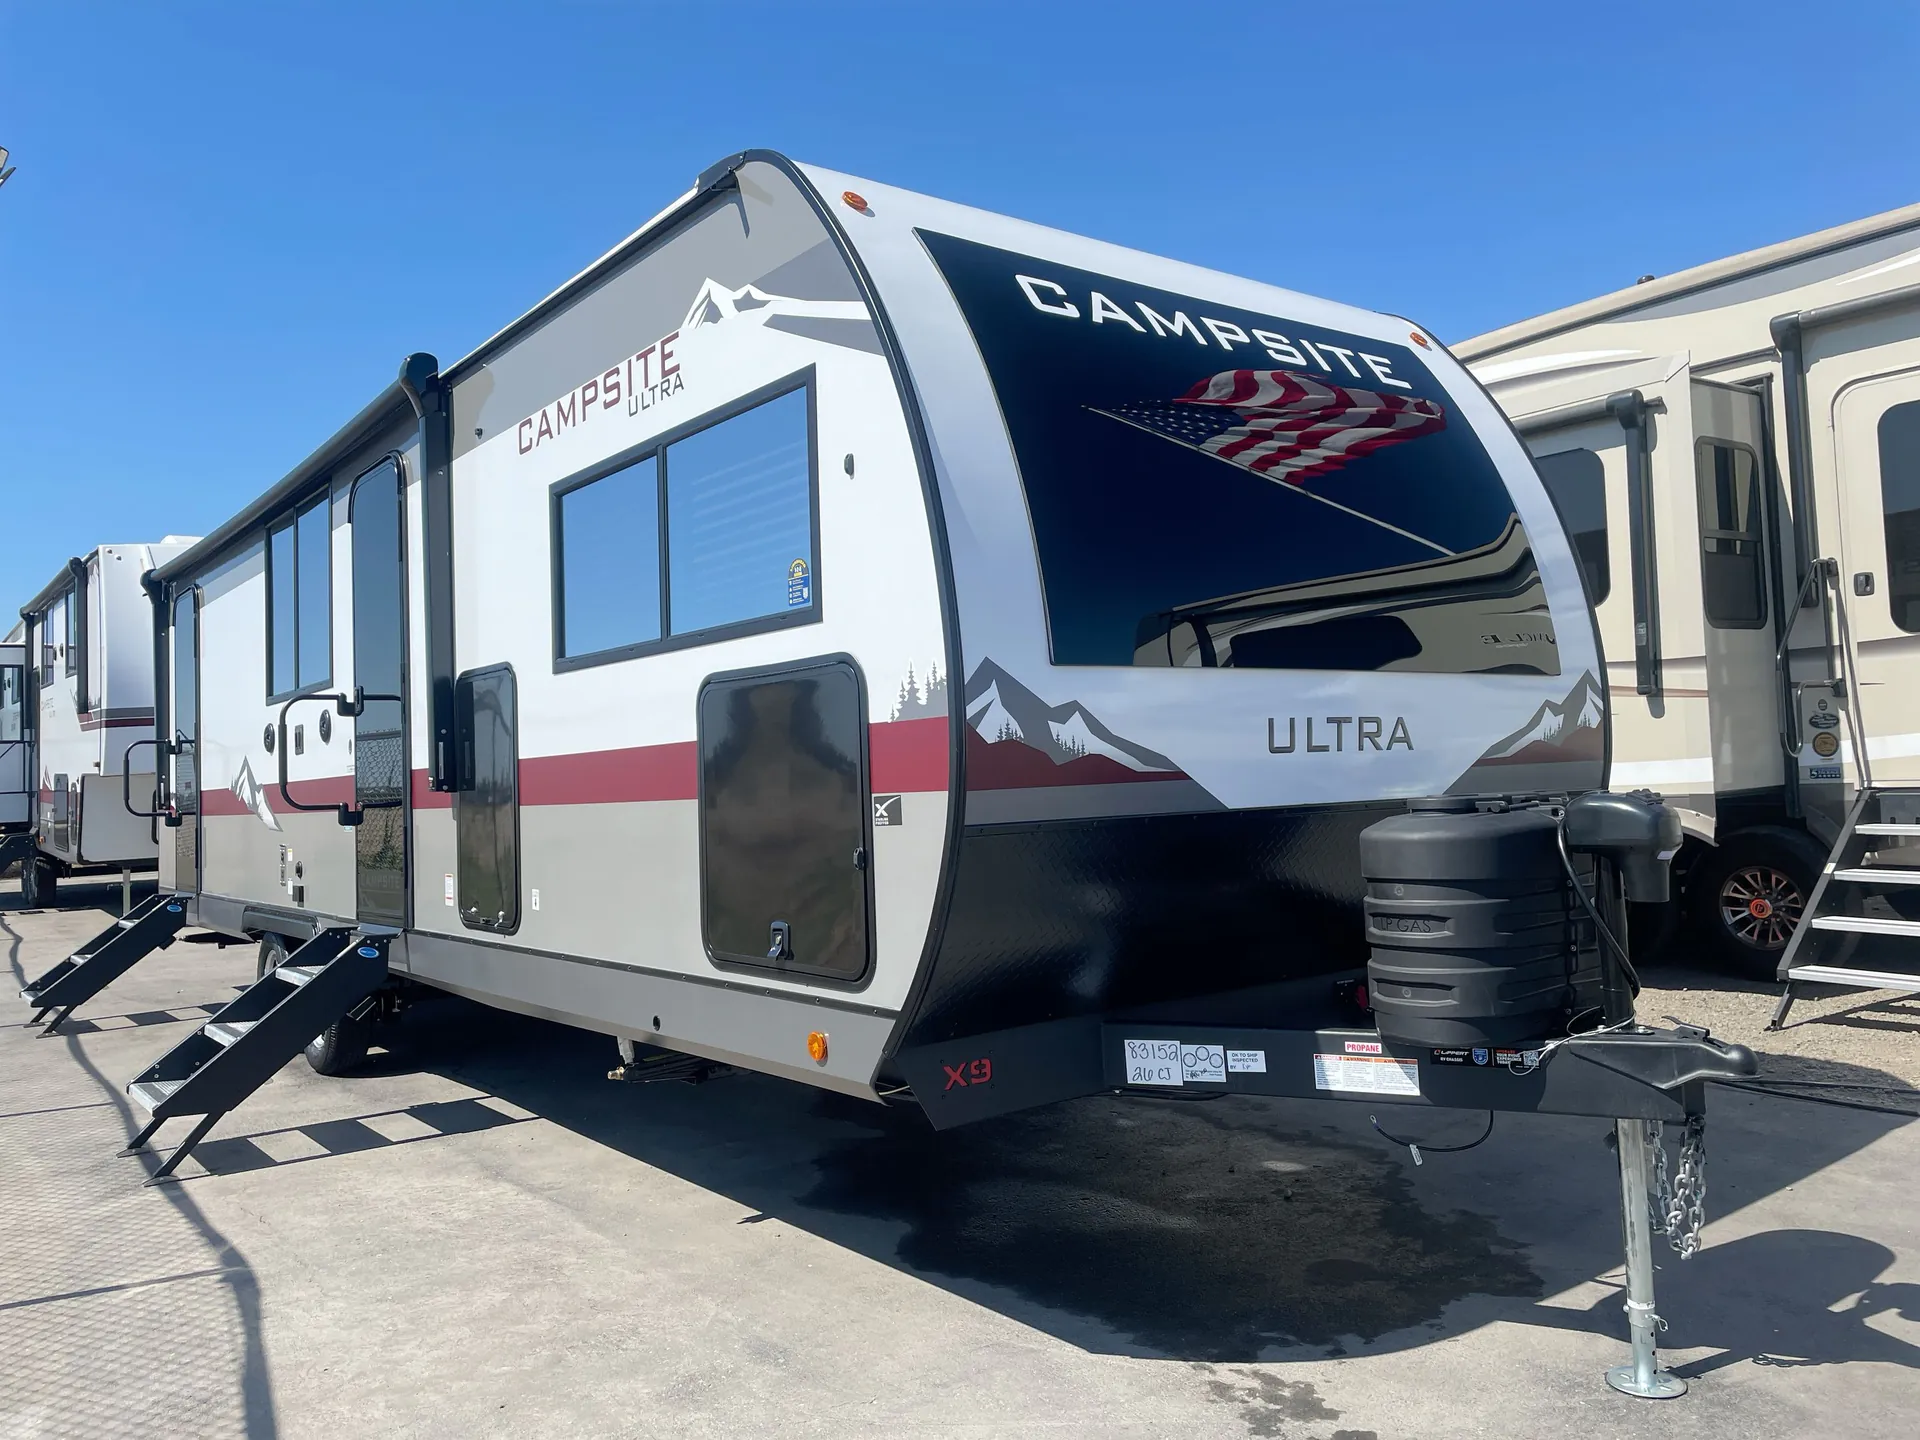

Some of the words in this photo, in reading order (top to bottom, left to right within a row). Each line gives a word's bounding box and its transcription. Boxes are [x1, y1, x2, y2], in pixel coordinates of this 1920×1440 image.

[1014, 273, 1413, 390] CAMPSITE
[518, 330, 681, 456] CAMPSITE
[627, 372, 685, 418] ULTRA
[1268, 716, 1415, 754] ULTRA
[1397, 918, 1432, 933] GAS
[1127, 1041, 1179, 1061] 83152
[1346, 1043, 1380, 1052] PROPANE
[943, 1058, 992, 1090] X9
